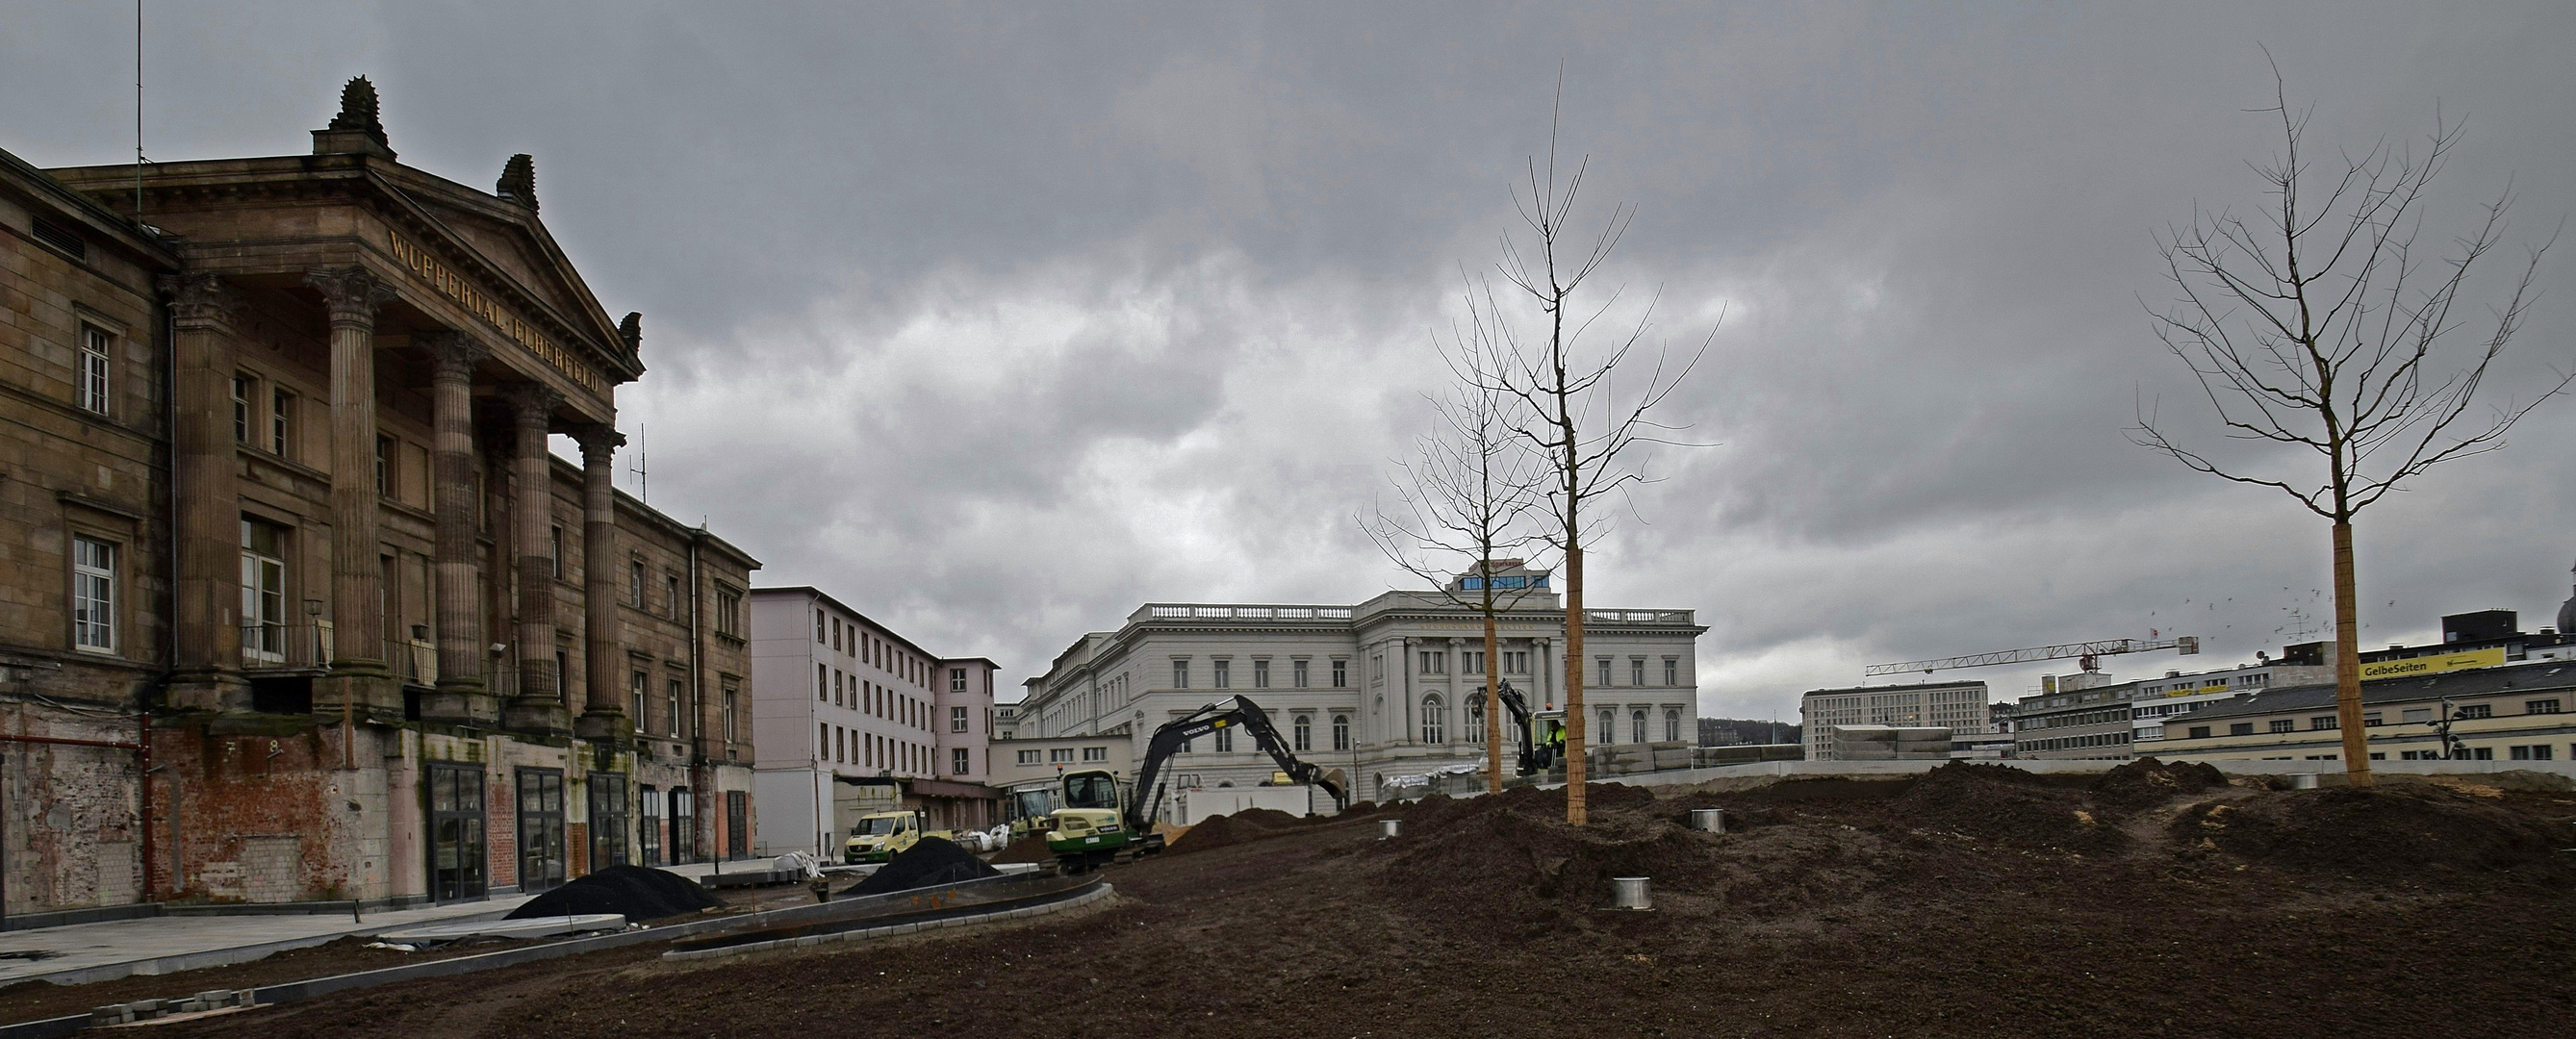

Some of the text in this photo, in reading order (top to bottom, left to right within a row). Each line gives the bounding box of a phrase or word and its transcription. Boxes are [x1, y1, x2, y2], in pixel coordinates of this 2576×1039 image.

[513, 318, 599, 393] ELBERFELD
[2364, 663, 2427, 676] GelbeSeiten
[1183, 725, 1210, 736] VOLVO
